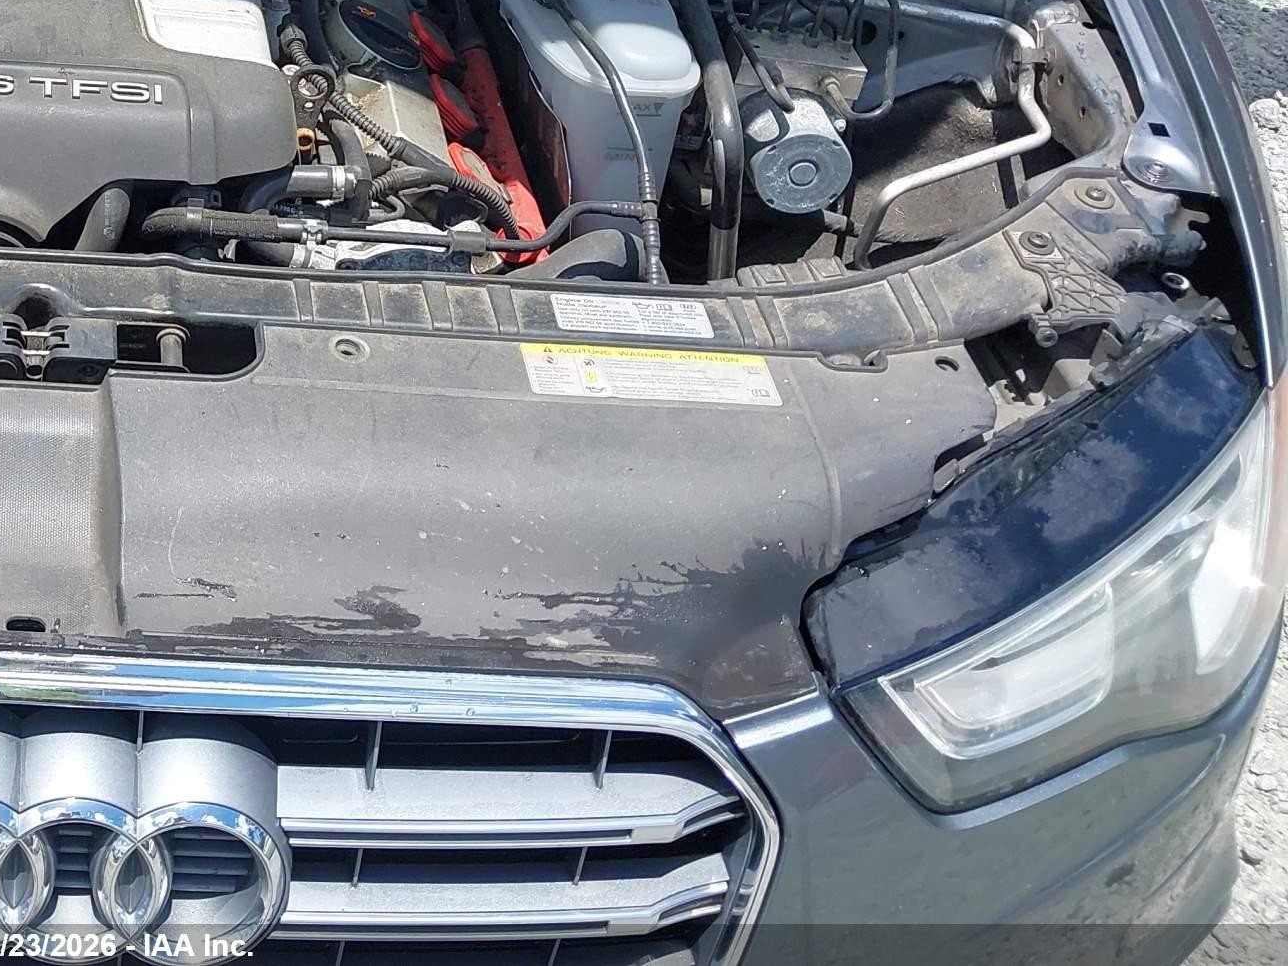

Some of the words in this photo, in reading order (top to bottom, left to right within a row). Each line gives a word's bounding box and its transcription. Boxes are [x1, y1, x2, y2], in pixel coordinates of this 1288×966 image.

[28, 76, 163, 105] TFSI
[558, 346, 613, 357] ACHTUNG
[618, 350, 673, 360] WARNING
[678, 353, 740, 364] ATTENTION
